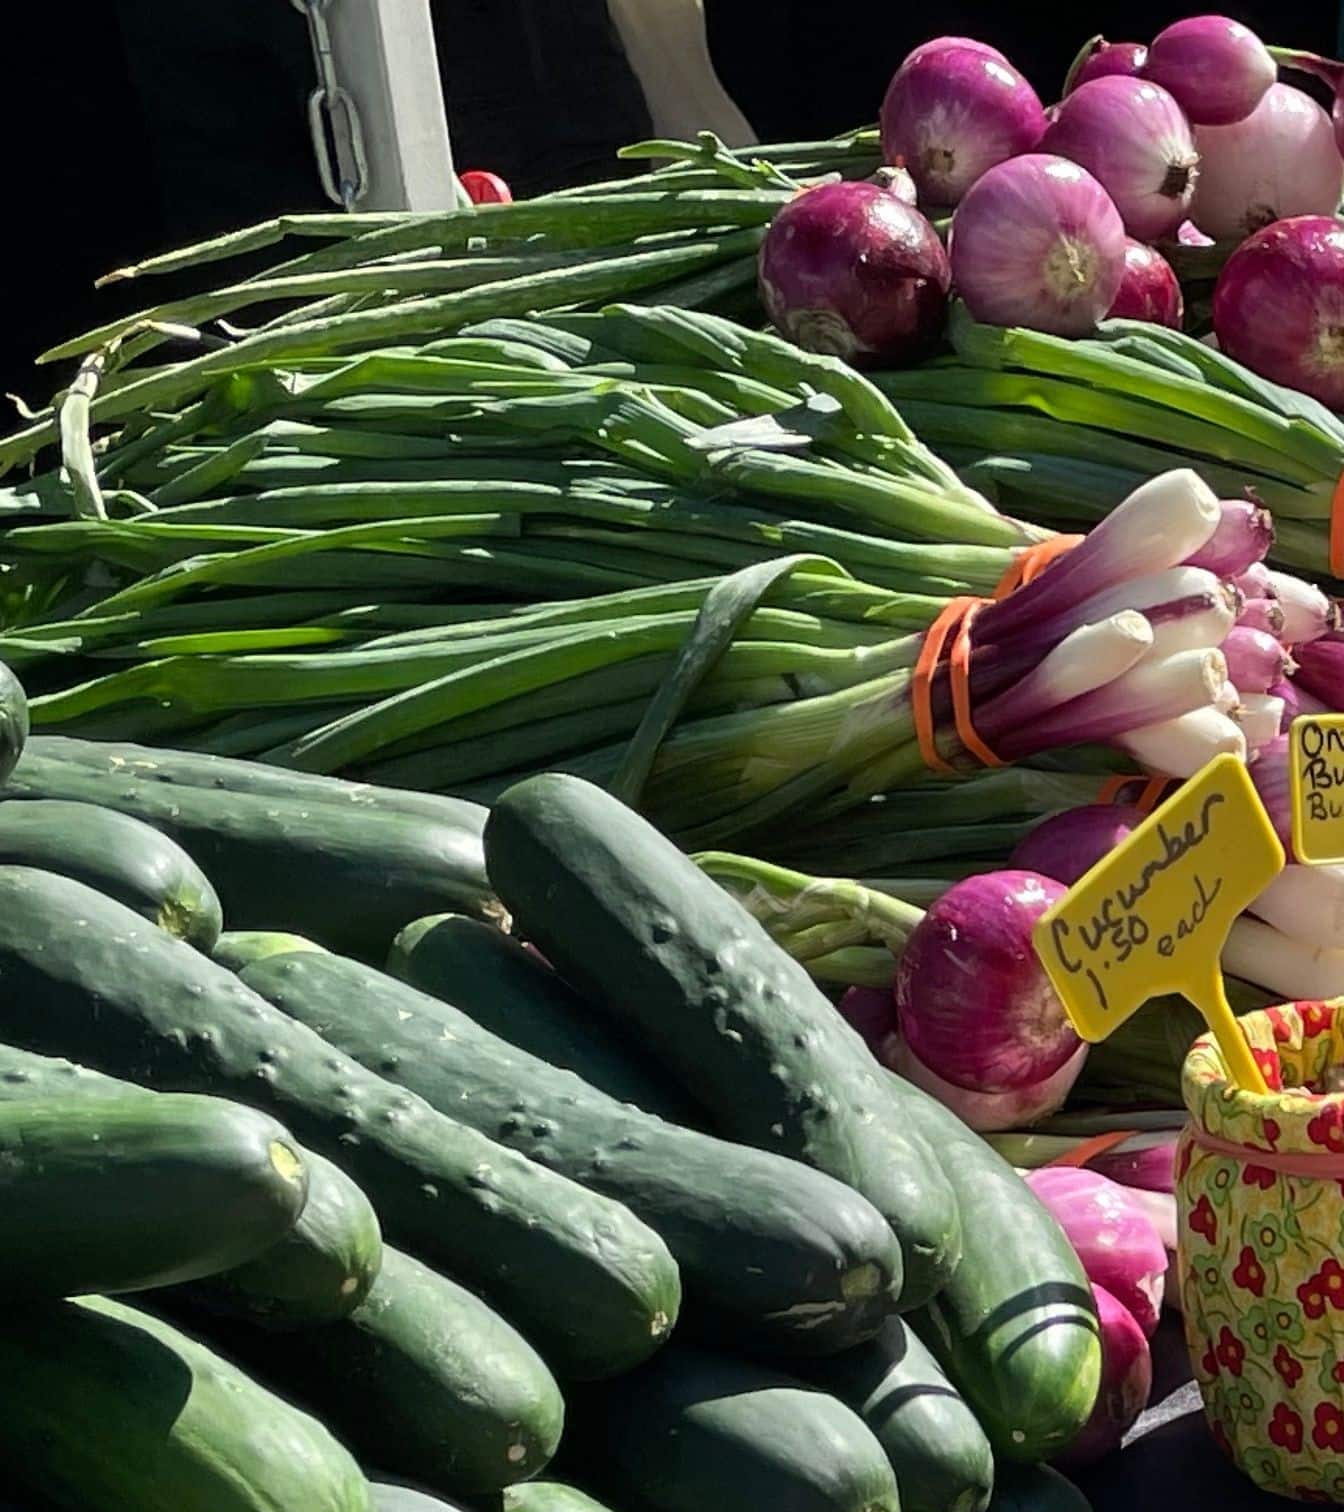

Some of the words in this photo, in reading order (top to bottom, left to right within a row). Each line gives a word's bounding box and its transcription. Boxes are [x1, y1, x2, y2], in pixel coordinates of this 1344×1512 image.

[1050, 793, 1225, 974] Cucumber
[1084, 915, 1149, 1010] 1.50
[1157, 875, 1223, 958] each
